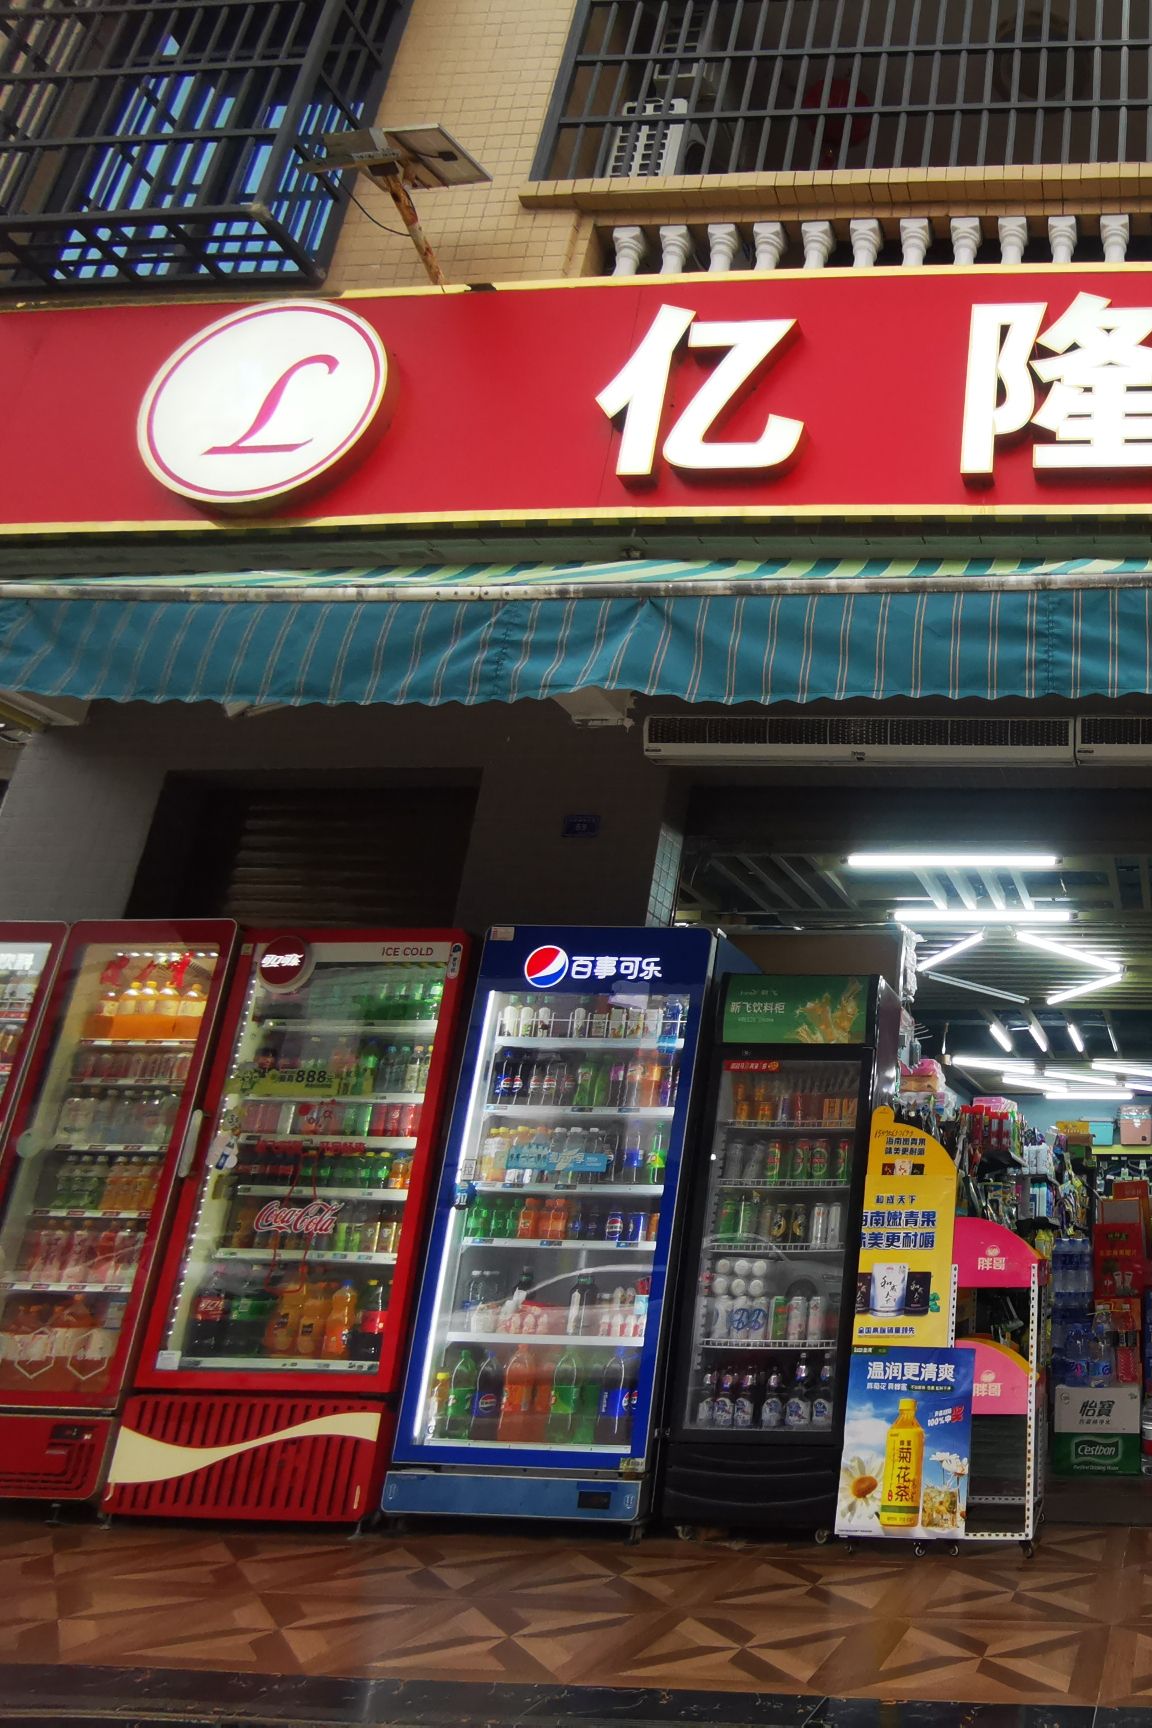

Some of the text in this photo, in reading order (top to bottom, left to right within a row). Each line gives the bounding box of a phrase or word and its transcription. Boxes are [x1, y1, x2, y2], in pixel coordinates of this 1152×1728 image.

[381, 946, 435, 957] ICE COLD
[570, 955, 663, 981] 百事可乐
[729, 1001, 786, 1015] 新飞饮料柜
[977, 1256, 1007, 1271] 胖哥
[866, 1361, 956, 1383] 温润更清爽
[973, 1382, 1002, 1398] 胖哥
[895, 1446, 913, 1503] 菊花茶
